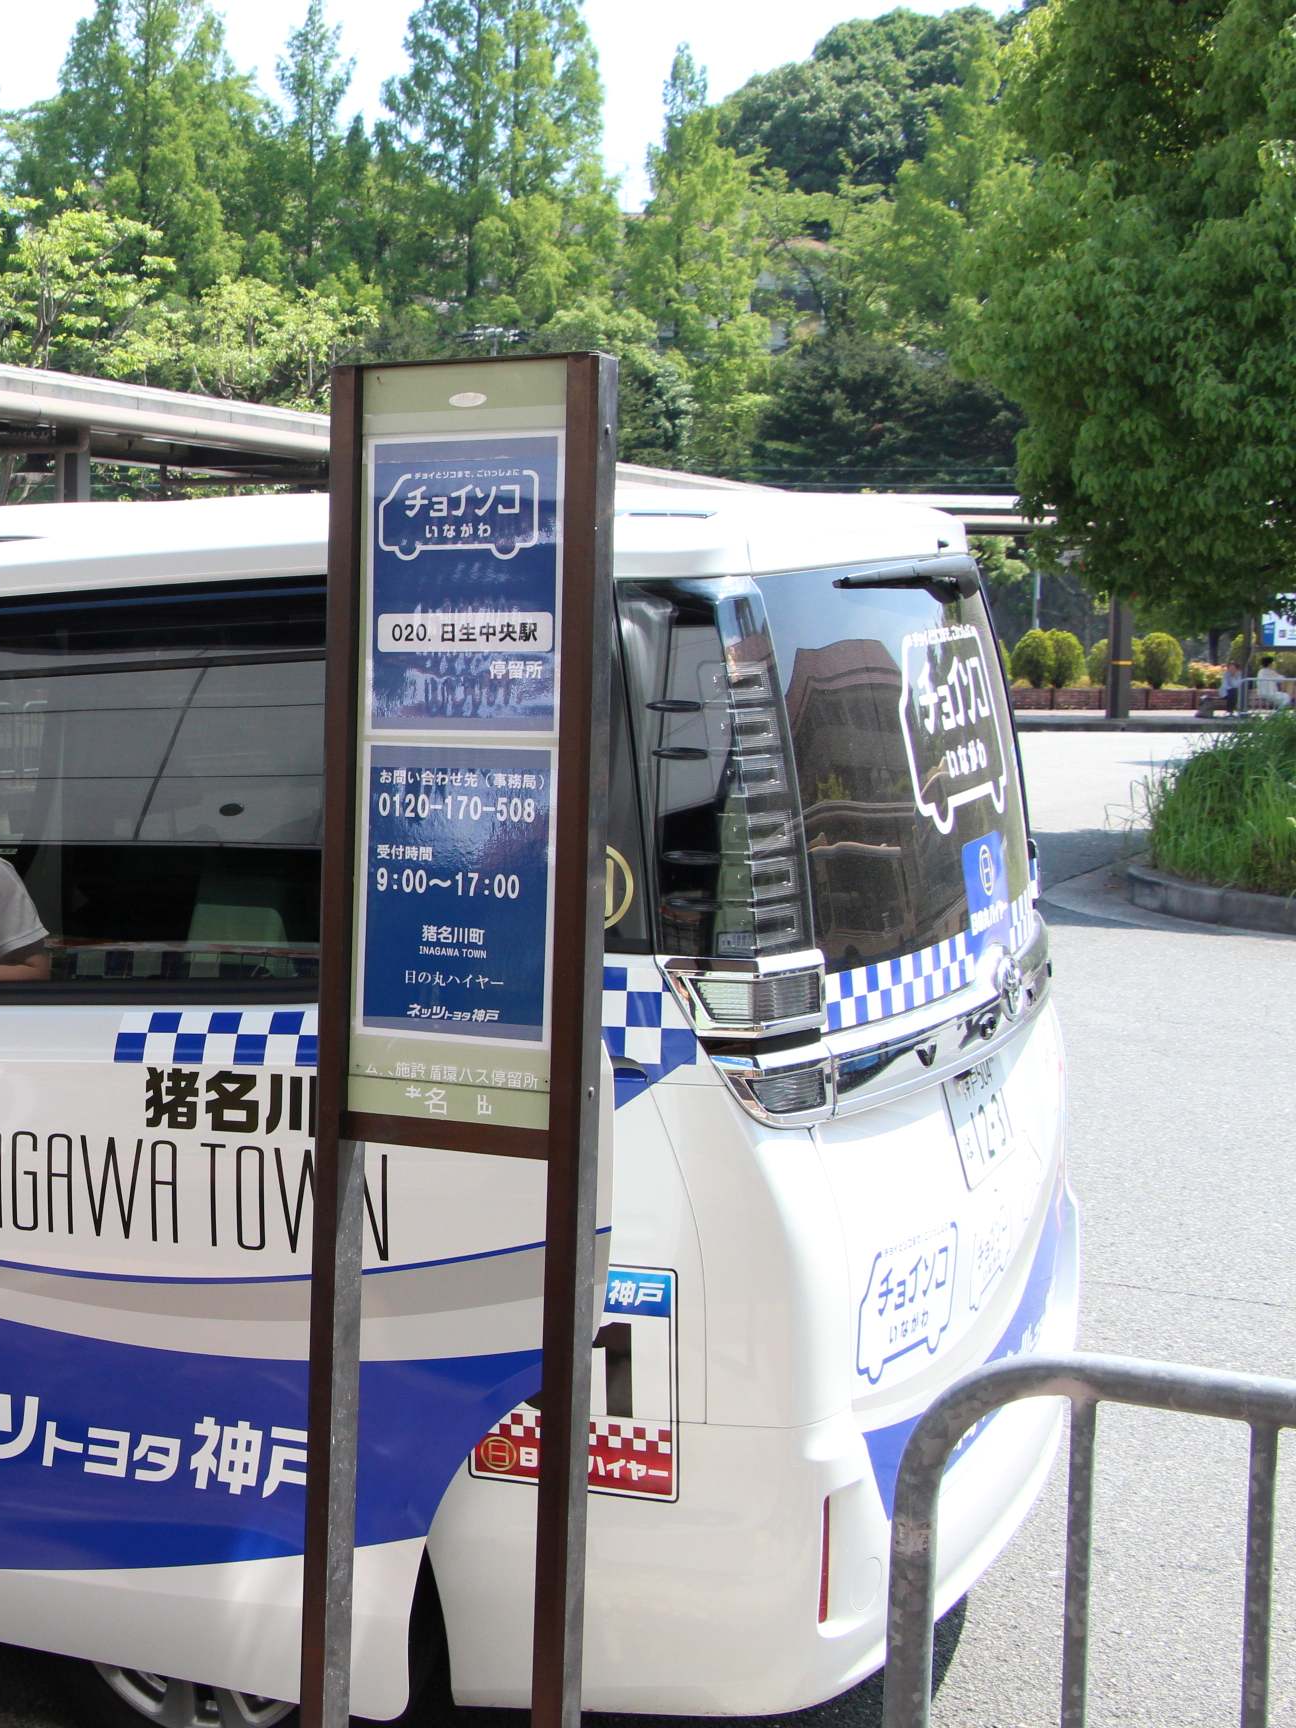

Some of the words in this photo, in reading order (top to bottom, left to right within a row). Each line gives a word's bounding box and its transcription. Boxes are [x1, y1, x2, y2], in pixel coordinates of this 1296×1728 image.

[405, 484, 521, 518] チョイソコ
[425, 522, 492, 538] いながわ
[440, 622, 538, 643] 日生中央駅
[489, 660, 543, 680] 停留所
[378, 792, 536, 823] 0120-170-508
[376, 844, 433, 862] 受付時間
[421, 924, 486, 946] 猪名川町
[419, 945, 460, 957] INAGAWA
[462, 948, 487, 959] TOWN
[404, 969, 505, 989] 日の丸ハイヤー
[406, 1003, 500, 1023] ネッツトヨタ神戸
[145, 1066, 317, 1138] 猪名川
[608, 1279, 666, 1307] 神戸
